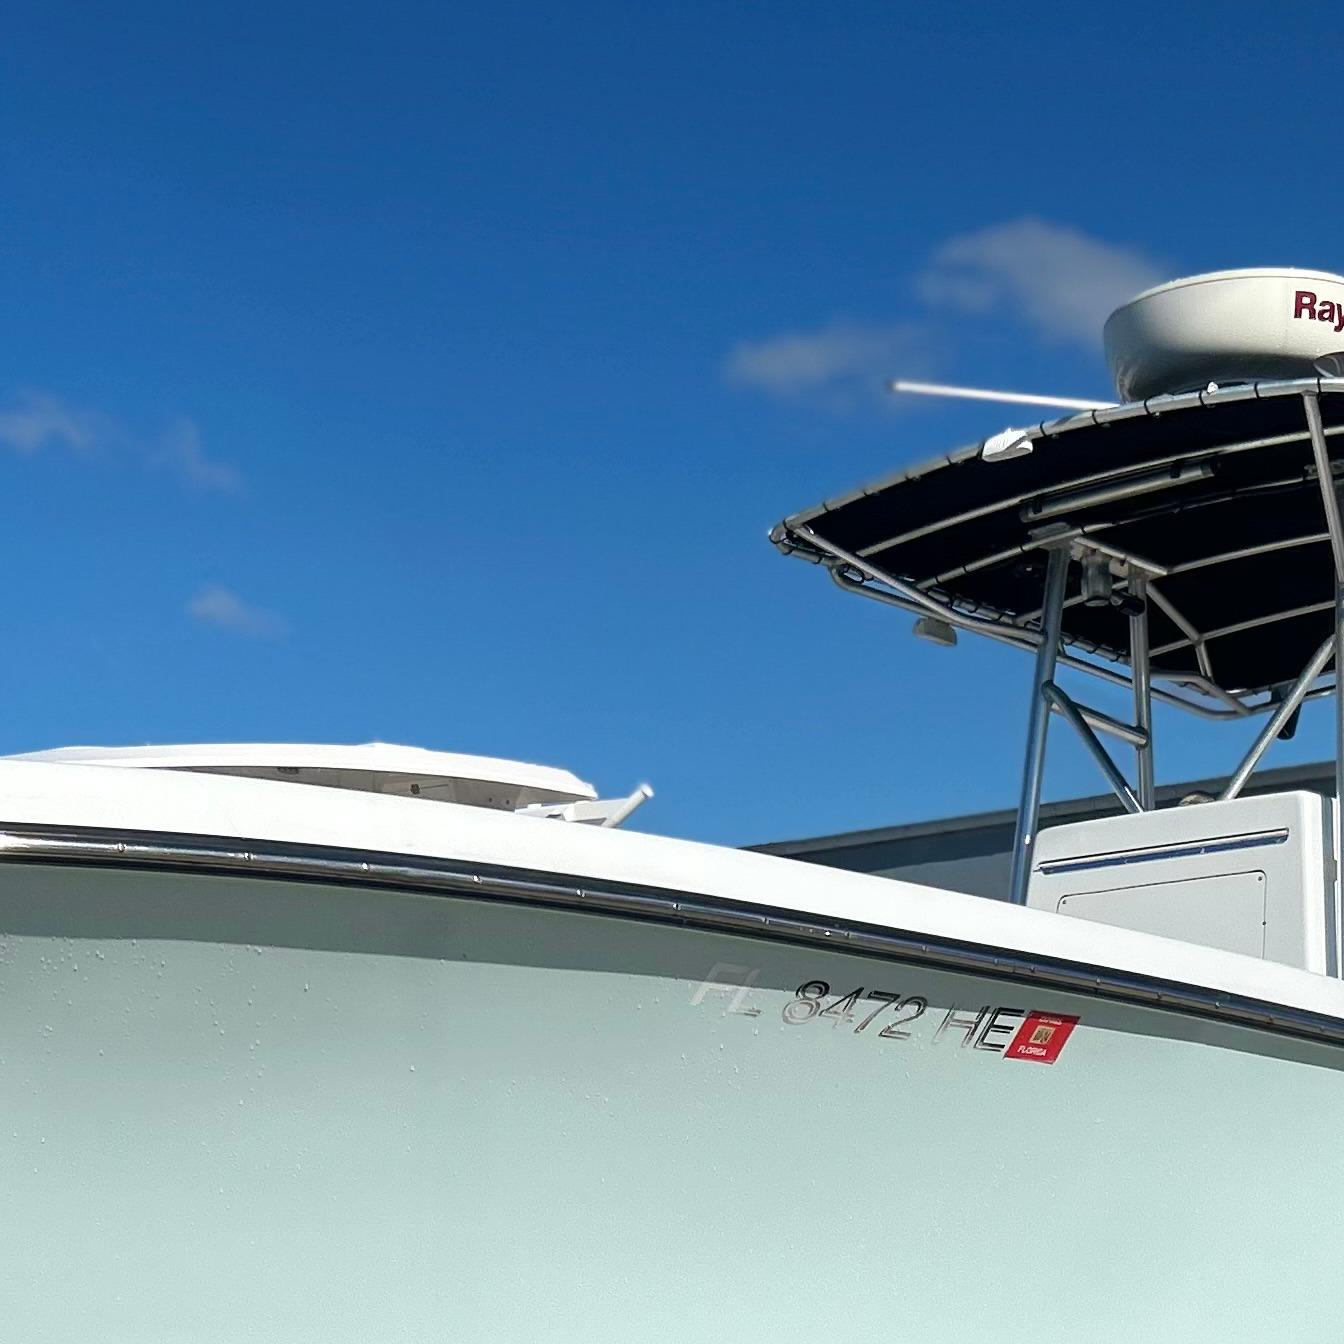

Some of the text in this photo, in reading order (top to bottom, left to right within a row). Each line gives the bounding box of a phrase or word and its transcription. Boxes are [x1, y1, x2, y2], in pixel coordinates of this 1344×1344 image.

[689, 961, 1025, 1053] FL 8472 HE
